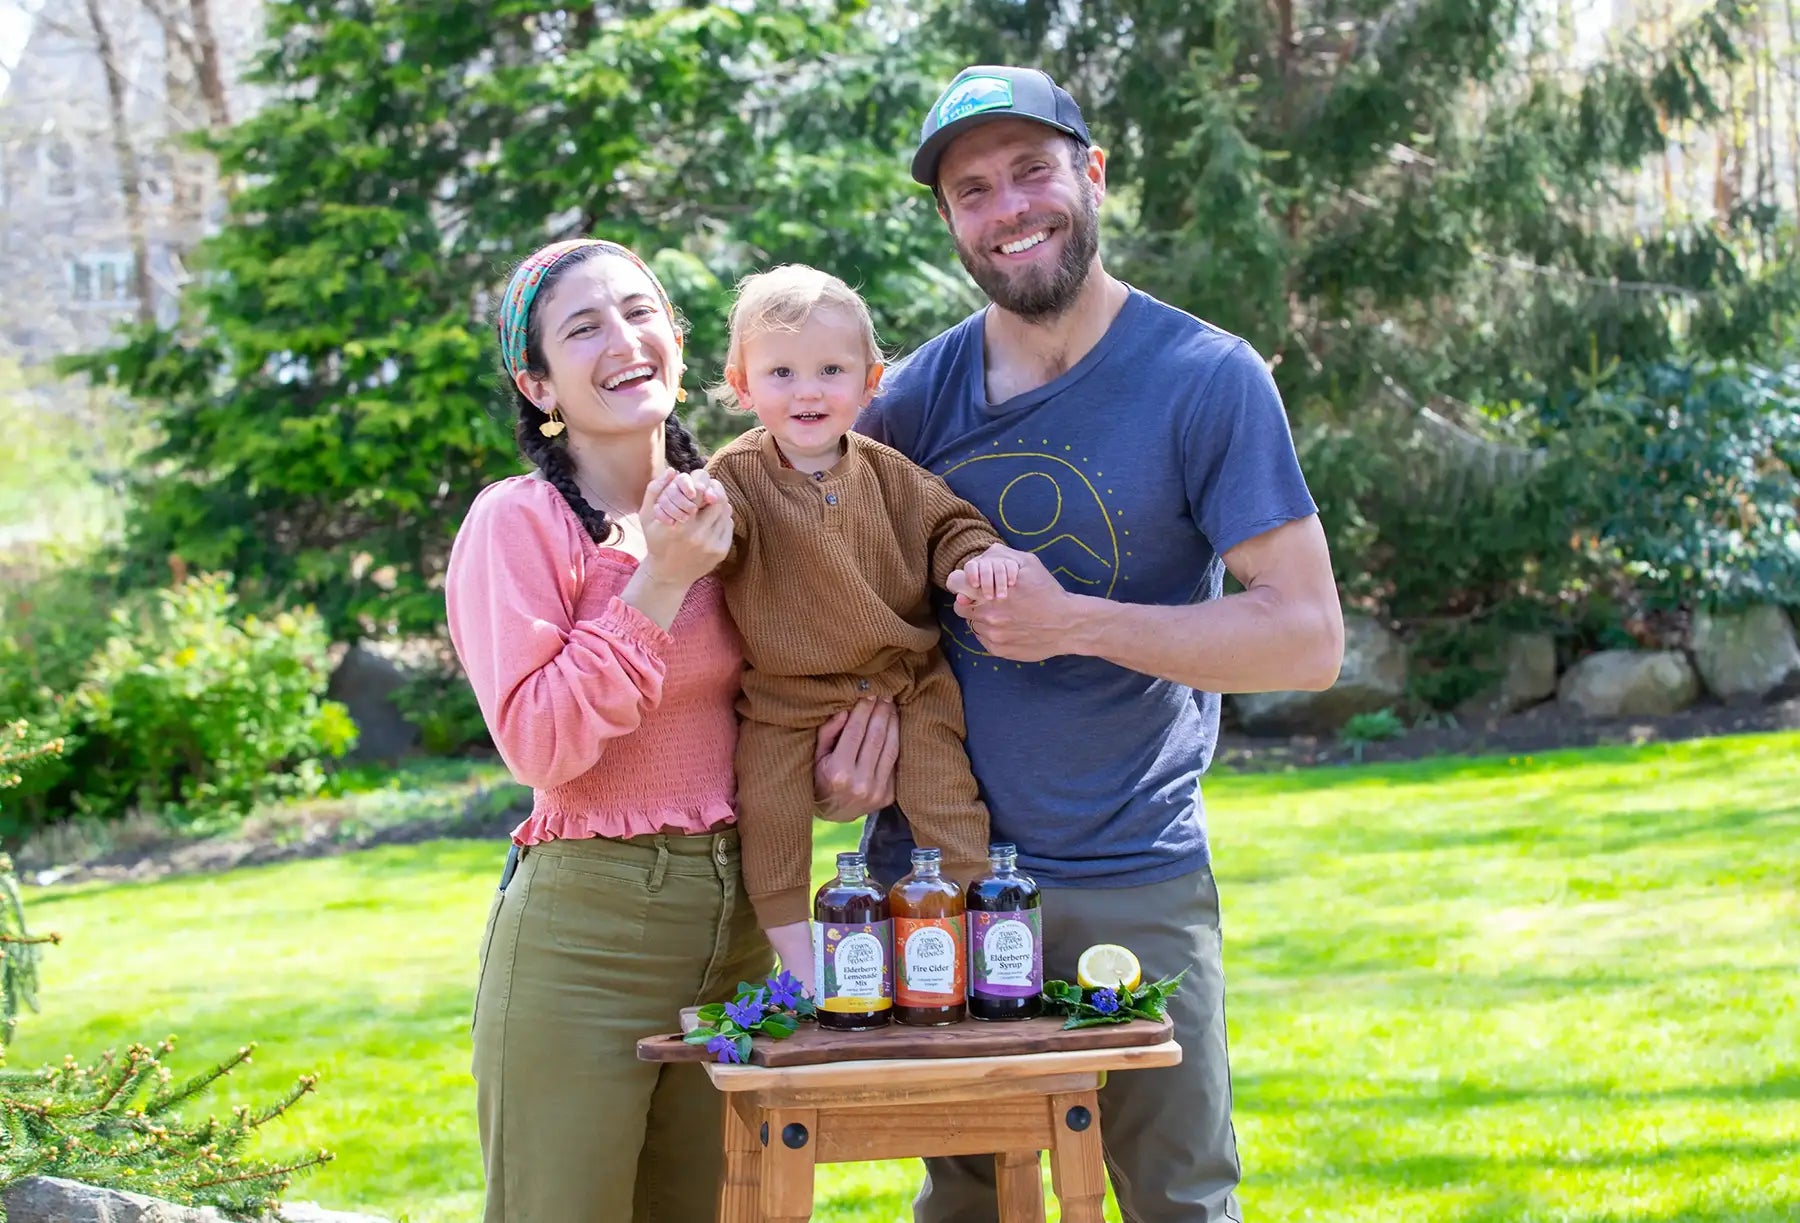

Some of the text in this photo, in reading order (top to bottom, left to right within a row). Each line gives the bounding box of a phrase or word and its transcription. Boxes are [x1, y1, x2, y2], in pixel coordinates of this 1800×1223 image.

[920, 950, 945, 958] TONICS
[990, 954, 1030, 962] Elderberry
[850, 956, 874, 964] TONICS
[929, 964, 949, 972] Cider
[999, 961, 1023, 970] Syrup
